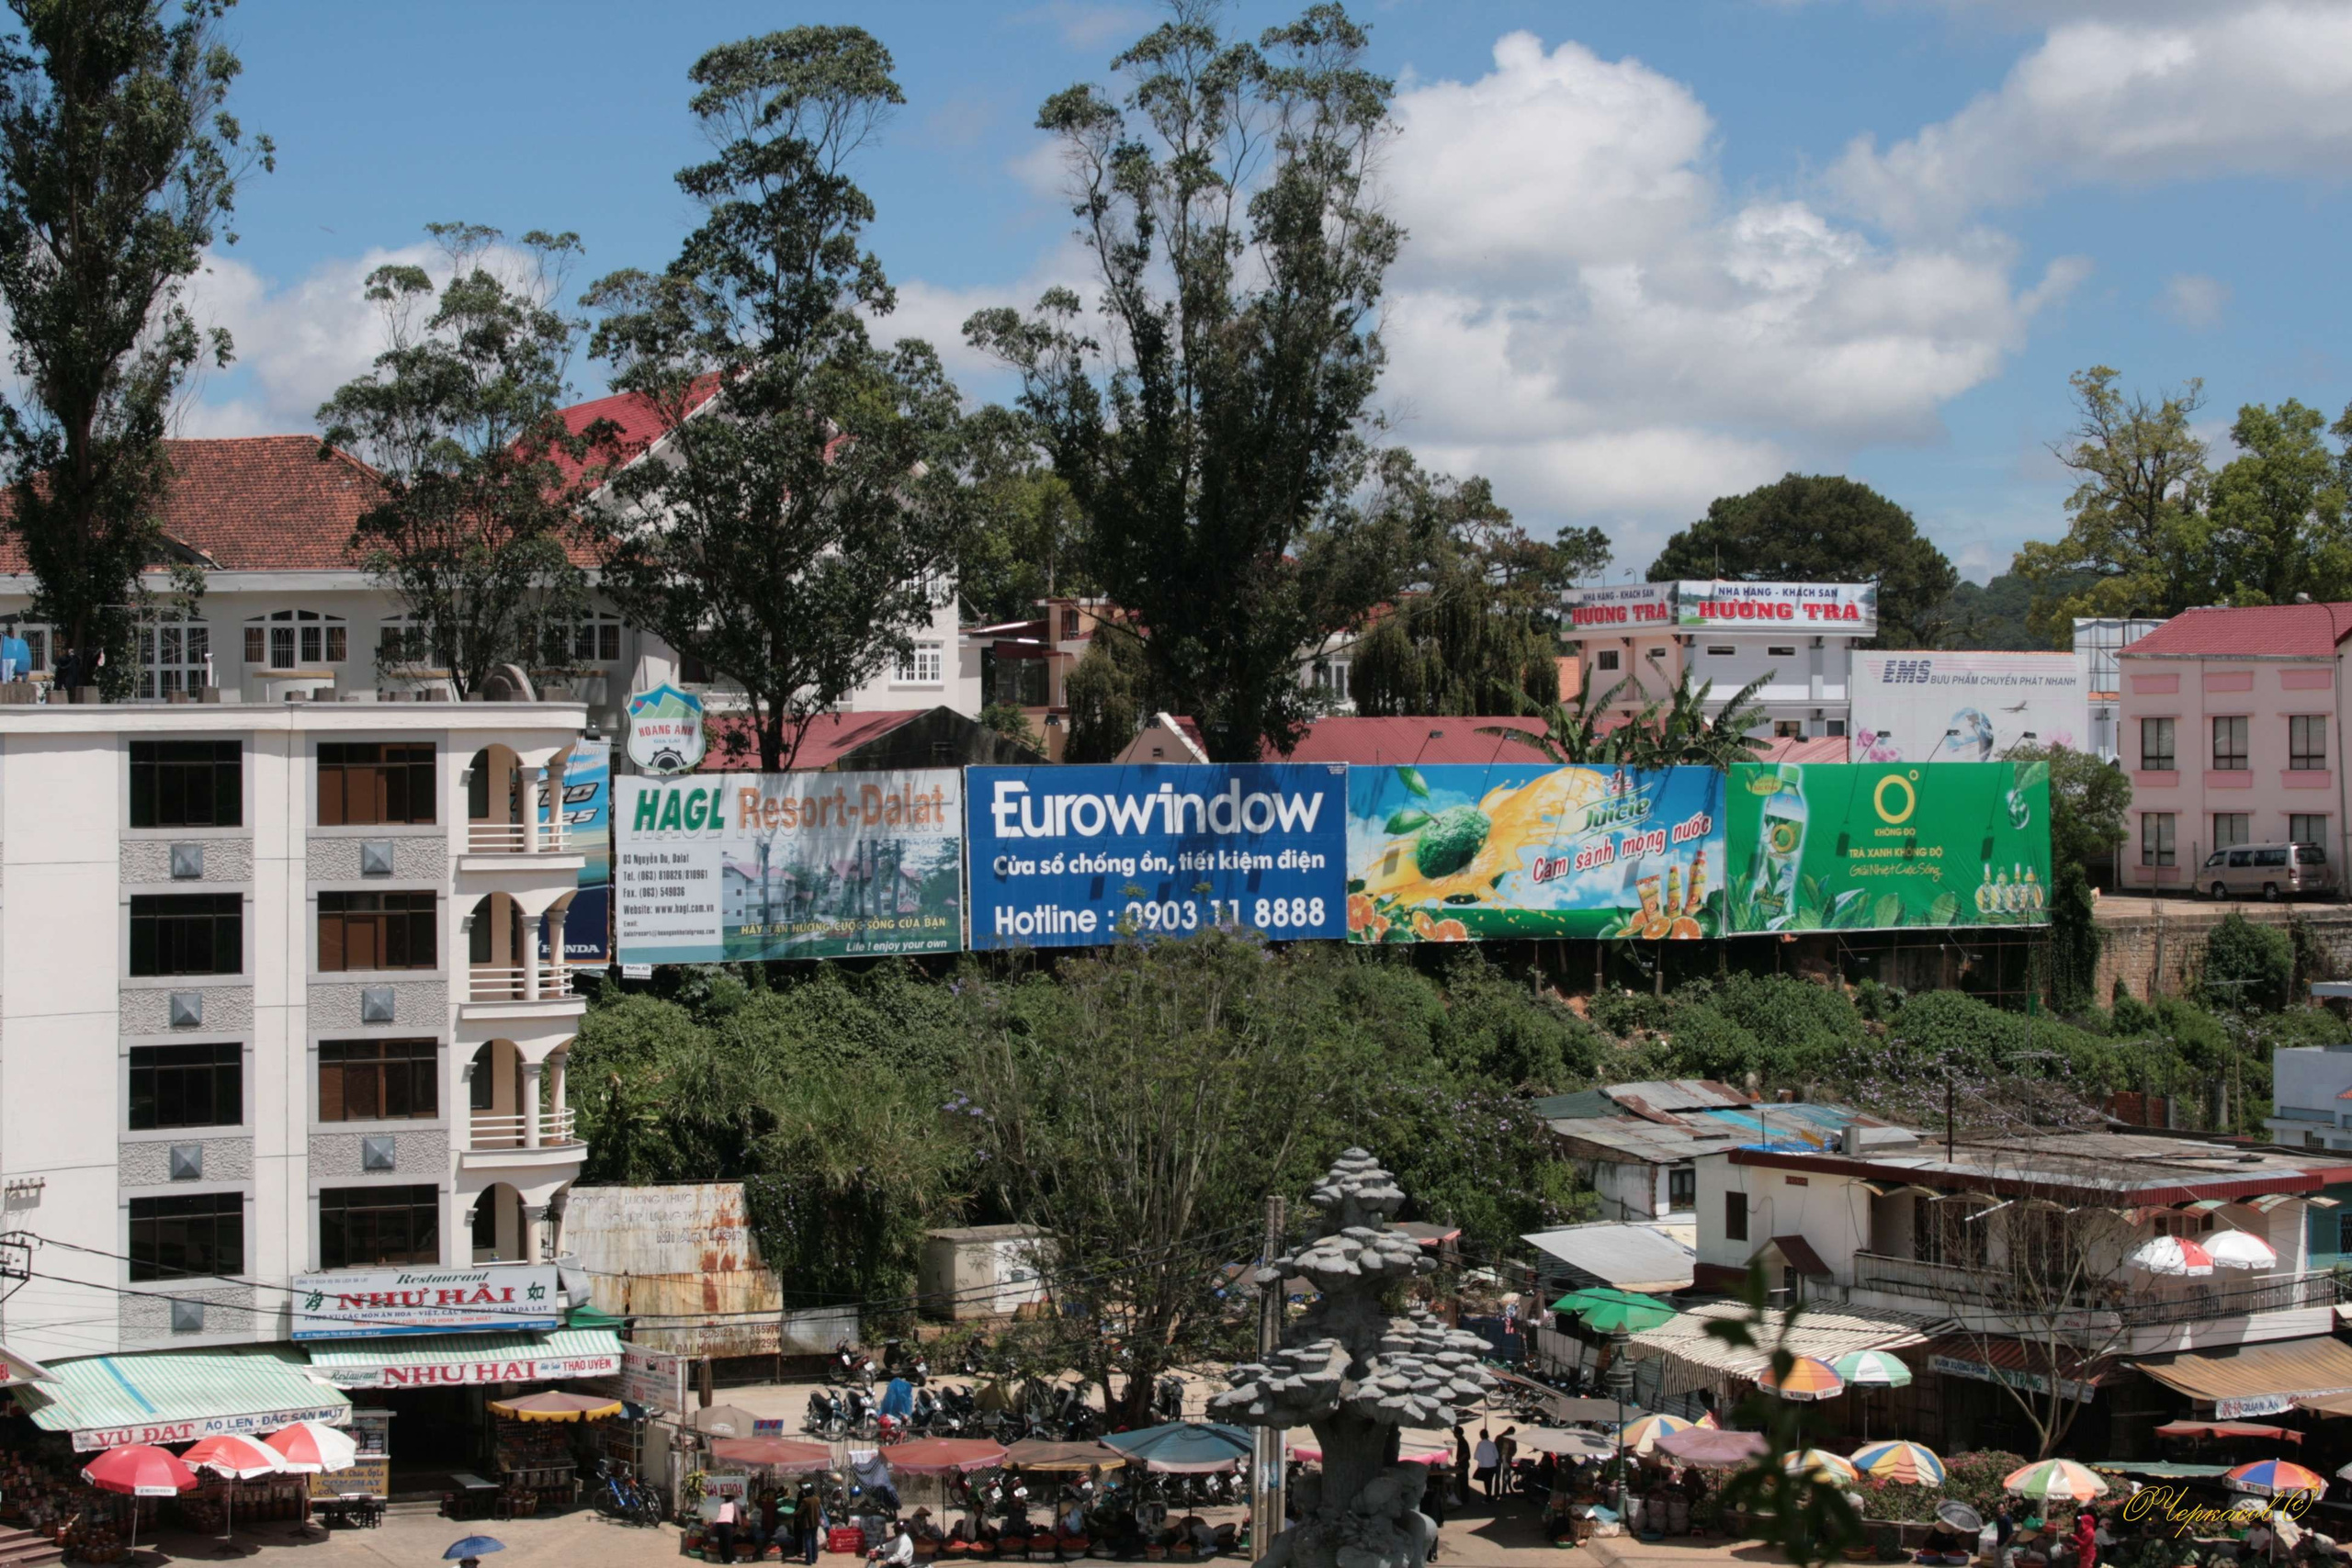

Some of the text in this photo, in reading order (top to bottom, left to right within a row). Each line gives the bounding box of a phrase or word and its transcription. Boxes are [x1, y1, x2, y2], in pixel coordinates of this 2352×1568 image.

[1632, 598, 1668, 622] TRÀ
[1698, 598, 1861, 621] HƯƠNG TRÀ
[1883, 660, 1931, 684] EMS
[2045, 676, 2076, 686] NHANH
[632, 787, 725, 833] HAGL
[739, 783, 946, 830] Resort-Dalat
[991, 778, 1324, 839] Eurowindow
[1579, 795, 1652, 833] Juicie
[1532, 811, 1713, 884] Cam sành mọng nước
[1867, 847, 1893, 858] XANH
[993, 854, 1035, 876] Cửa
[1040, 852, 1065, 874] sổ
[1069, 852, 1136, 877] chống
[1179, 849, 1216, 871] tiết
[1218, 849, 1272, 875] kiệm
[1277, 849, 1325, 874] điện
[995, 905, 1097, 936] Hotline
[1254, 897, 1325, 928] 8888
[541, 944, 600, 953] HNDA
[846, 942, 865, 953] Life
[873, 942, 899, 953] enjoy
[902, 941, 924, 952] your
[927, 941, 947, 949] own
[396, 1271, 490, 1285] Restaurant
[336, 1287, 430, 1311] NHƯ
[331, 1369, 378, 1381] Restaurant
[383, 1362, 467, 1385] NHƯ
[587, 1356, 612, 1371] UYÊN
[227, 1417, 254, 1428] LEN
